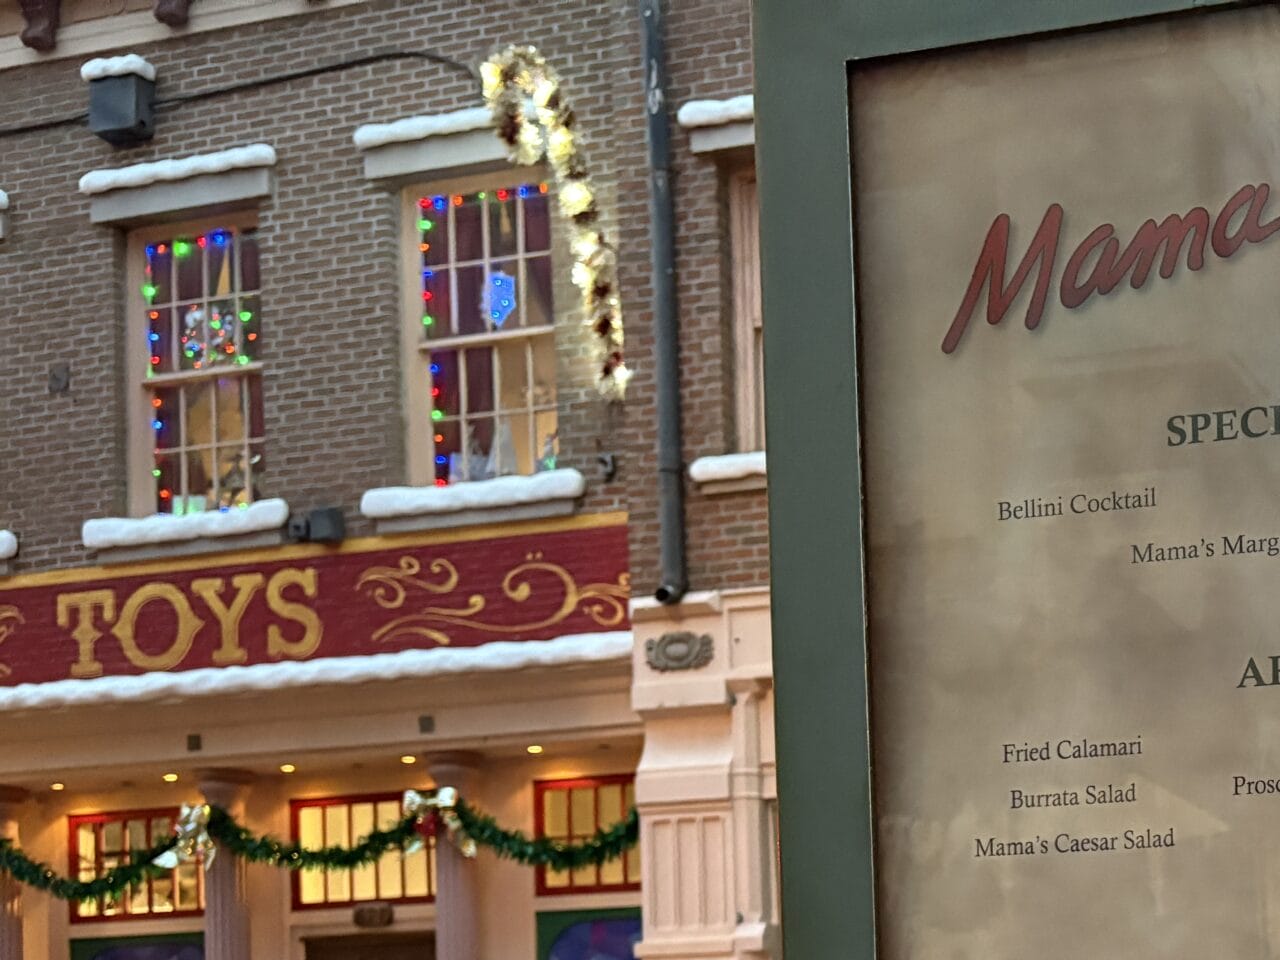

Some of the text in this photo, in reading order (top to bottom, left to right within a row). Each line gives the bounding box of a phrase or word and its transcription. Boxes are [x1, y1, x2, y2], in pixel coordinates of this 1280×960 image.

[998, 487, 1156, 521] Bellini Cocktail
[1131, 538, 1215, 564] Mama's
[56, 567, 323, 677] TOYS
[1003, 735, 1142, 763] Fried Calamari
[1010, 783, 1137, 809] Burrata Salad
[975, 827, 1175, 857] Mama's Caesar Salad
